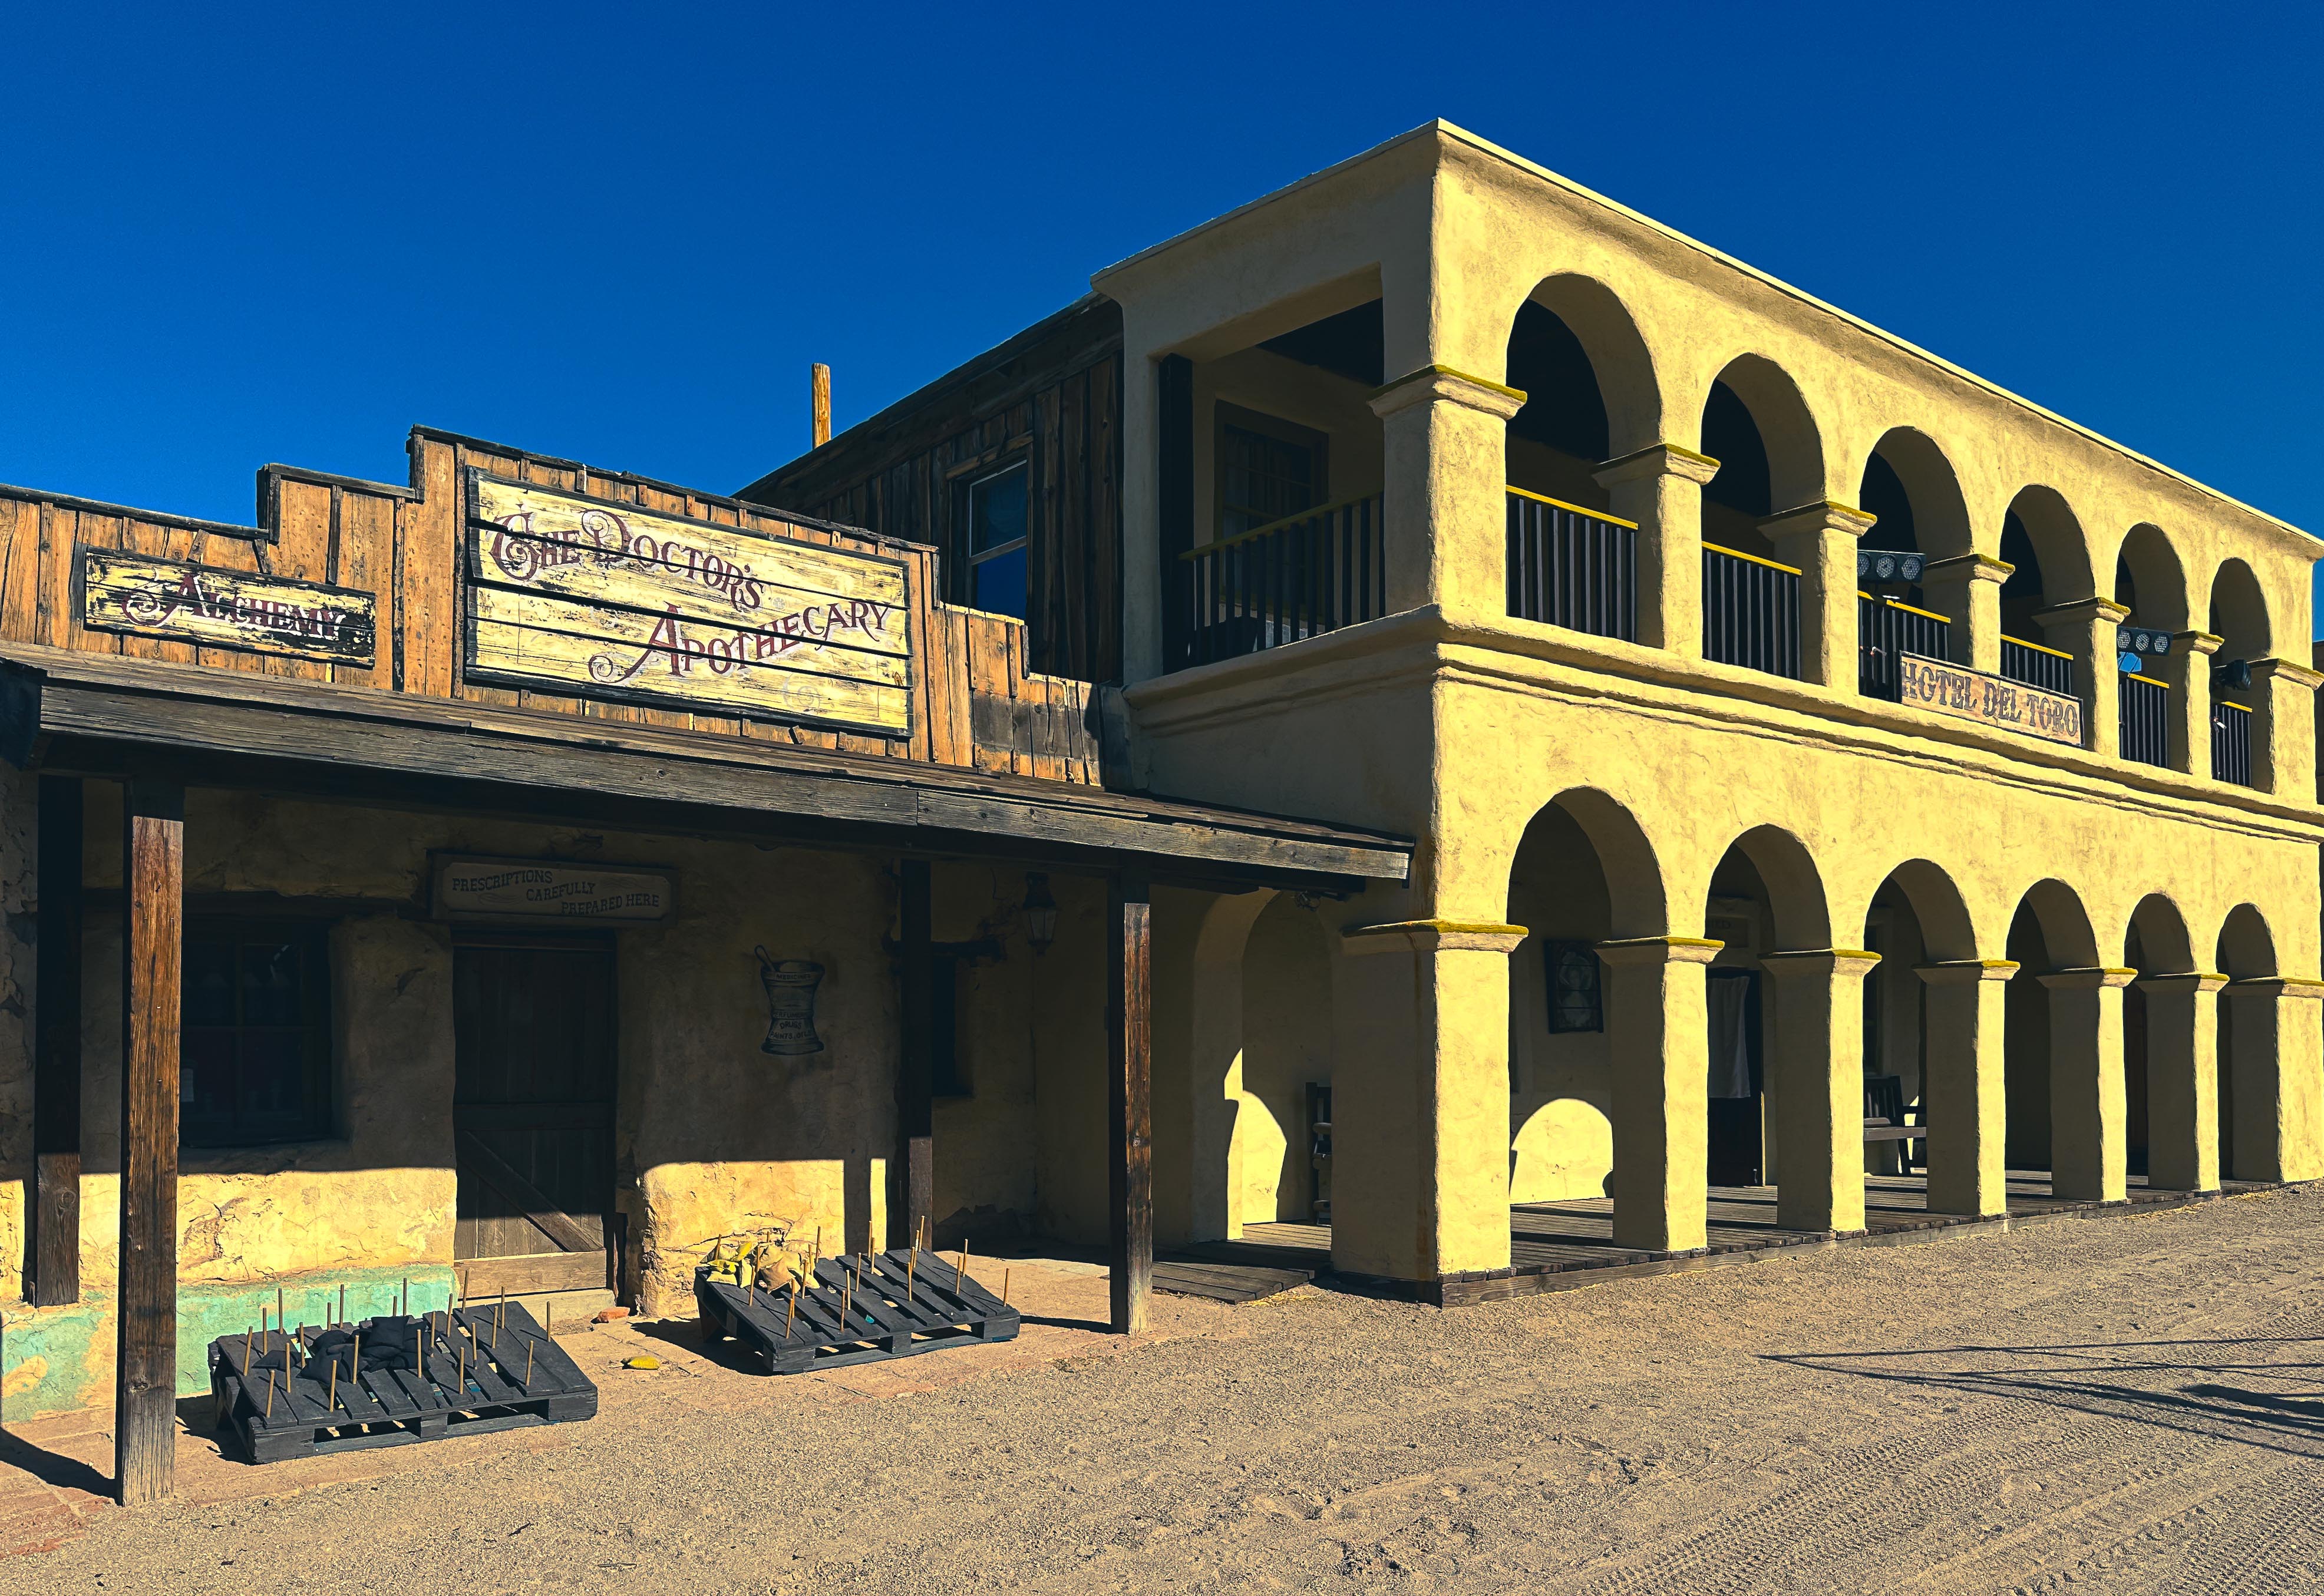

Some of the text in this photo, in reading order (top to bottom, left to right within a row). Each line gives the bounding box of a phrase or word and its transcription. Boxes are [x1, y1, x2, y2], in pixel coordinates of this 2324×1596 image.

[488, 507, 764, 612] THE DOCTOR'S
[121, 573, 346, 637] ALCHEMY
[588, 601, 889, 683] APOTHECARY
[1902, 661, 2079, 737] HOTEL DEL TORO
[452, 870, 553, 893] PRESCRIPTIONS
[526, 881, 596, 902] CAREFULLY
[561, 893, 660, 915] PREPARED HERE
[779, 1021, 802, 1030] DRUGS
